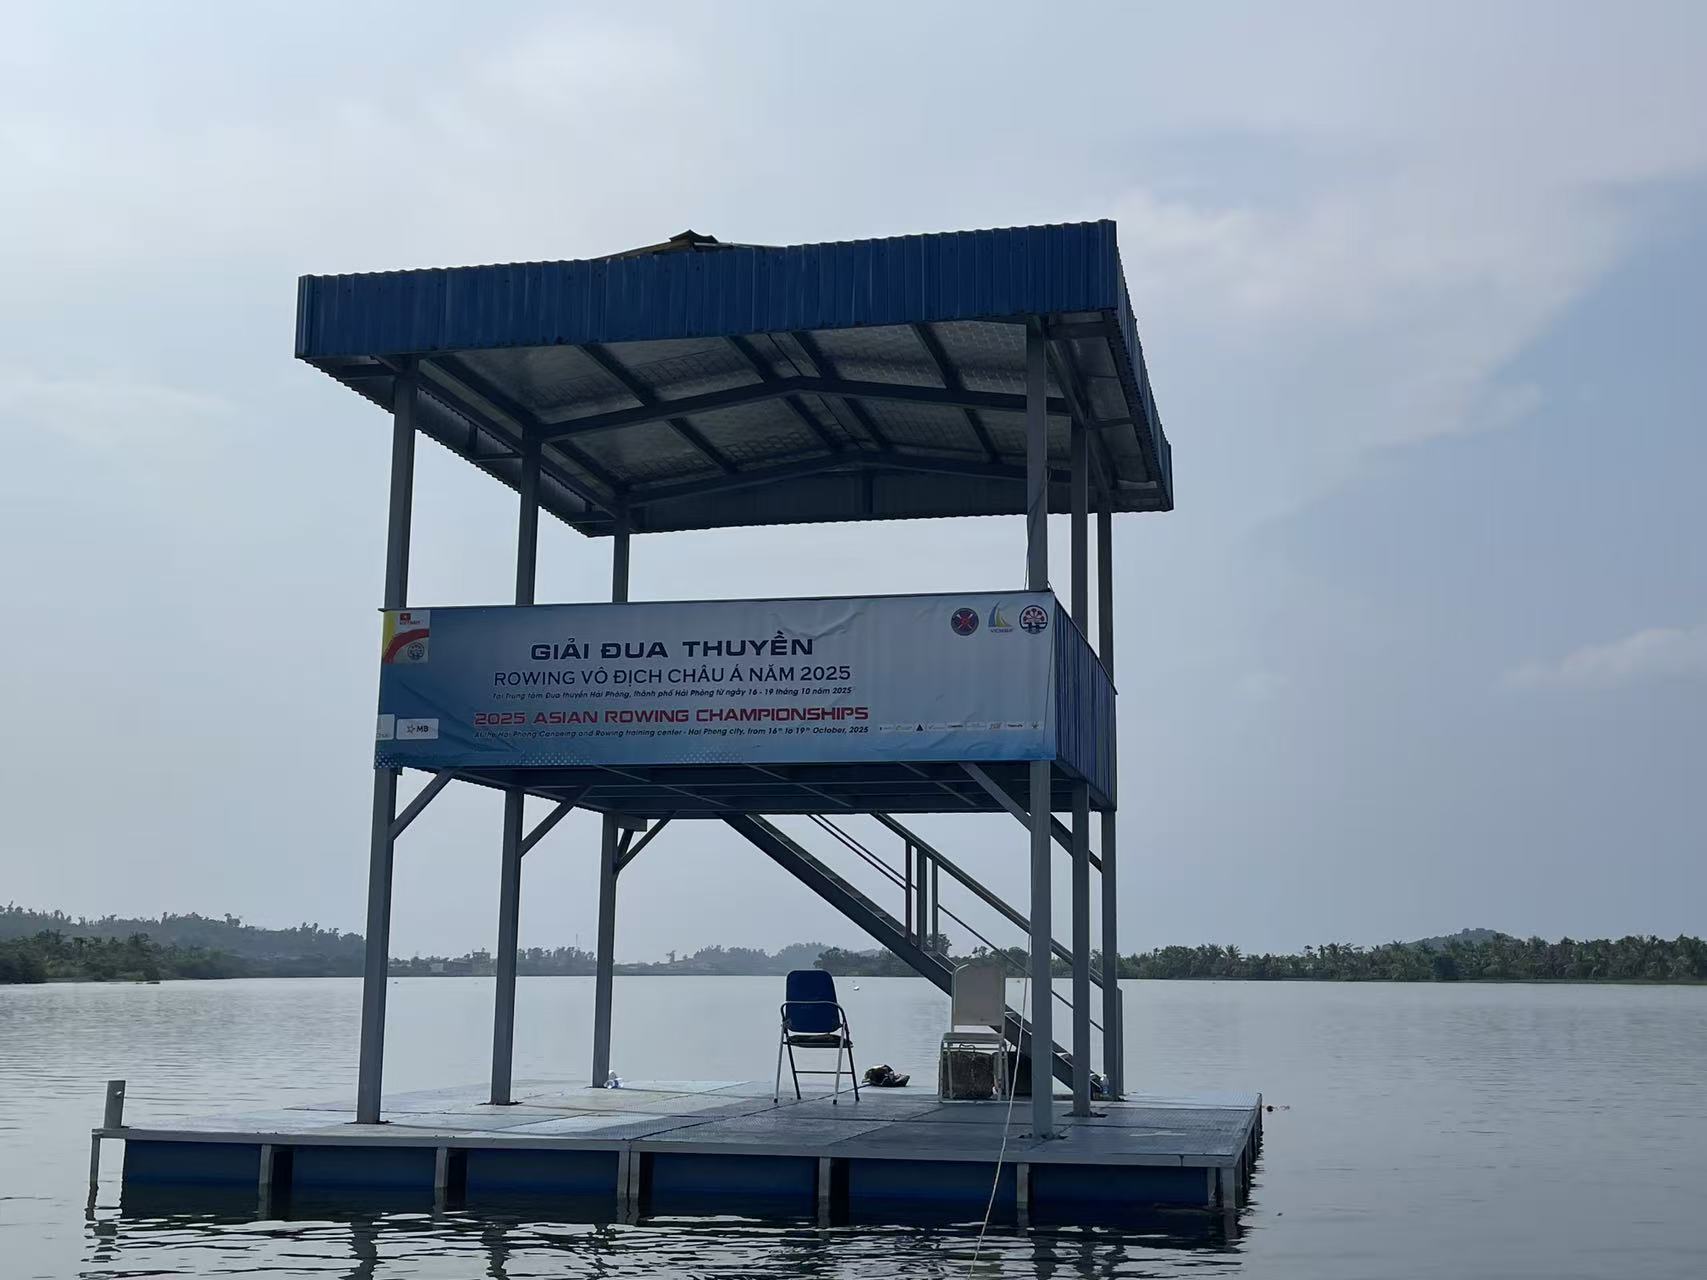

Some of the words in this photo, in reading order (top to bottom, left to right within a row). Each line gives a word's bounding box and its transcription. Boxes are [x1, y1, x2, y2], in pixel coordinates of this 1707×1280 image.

[531, 637, 589, 661] GIẢI
[601, 642, 668, 660] ĐUA
[683, 630, 813, 658] THUYỀN
[494, 671, 575, 686] ROWING
[581, 666, 608, 685] VÔ
[613, 669, 662, 687] ĐỊCH
[668, 664, 724, 684] CHÂU
[730, 664, 743, 682] Á
[749, 664, 795, 682] NĂM
[800, 665, 851, 682] 2025
[749, 688, 758, 696] 16
[802, 687, 811, 695] 10
[832, 686, 852, 694] 2025
[475, 712, 526, 725] 2025
[533, 710, 598, 725] ASIAN
[605, 709, 689, 724] ROWING
[696, 706, 869, 722] CHAMPIONSHIPS
[416, 725, 429, 733] MB
[595, 728, 623, 737] Rowing
[626, 728, 655, 737] training
[658, 728, 682, 736] center
[848, 725, 869, 733] 2025
